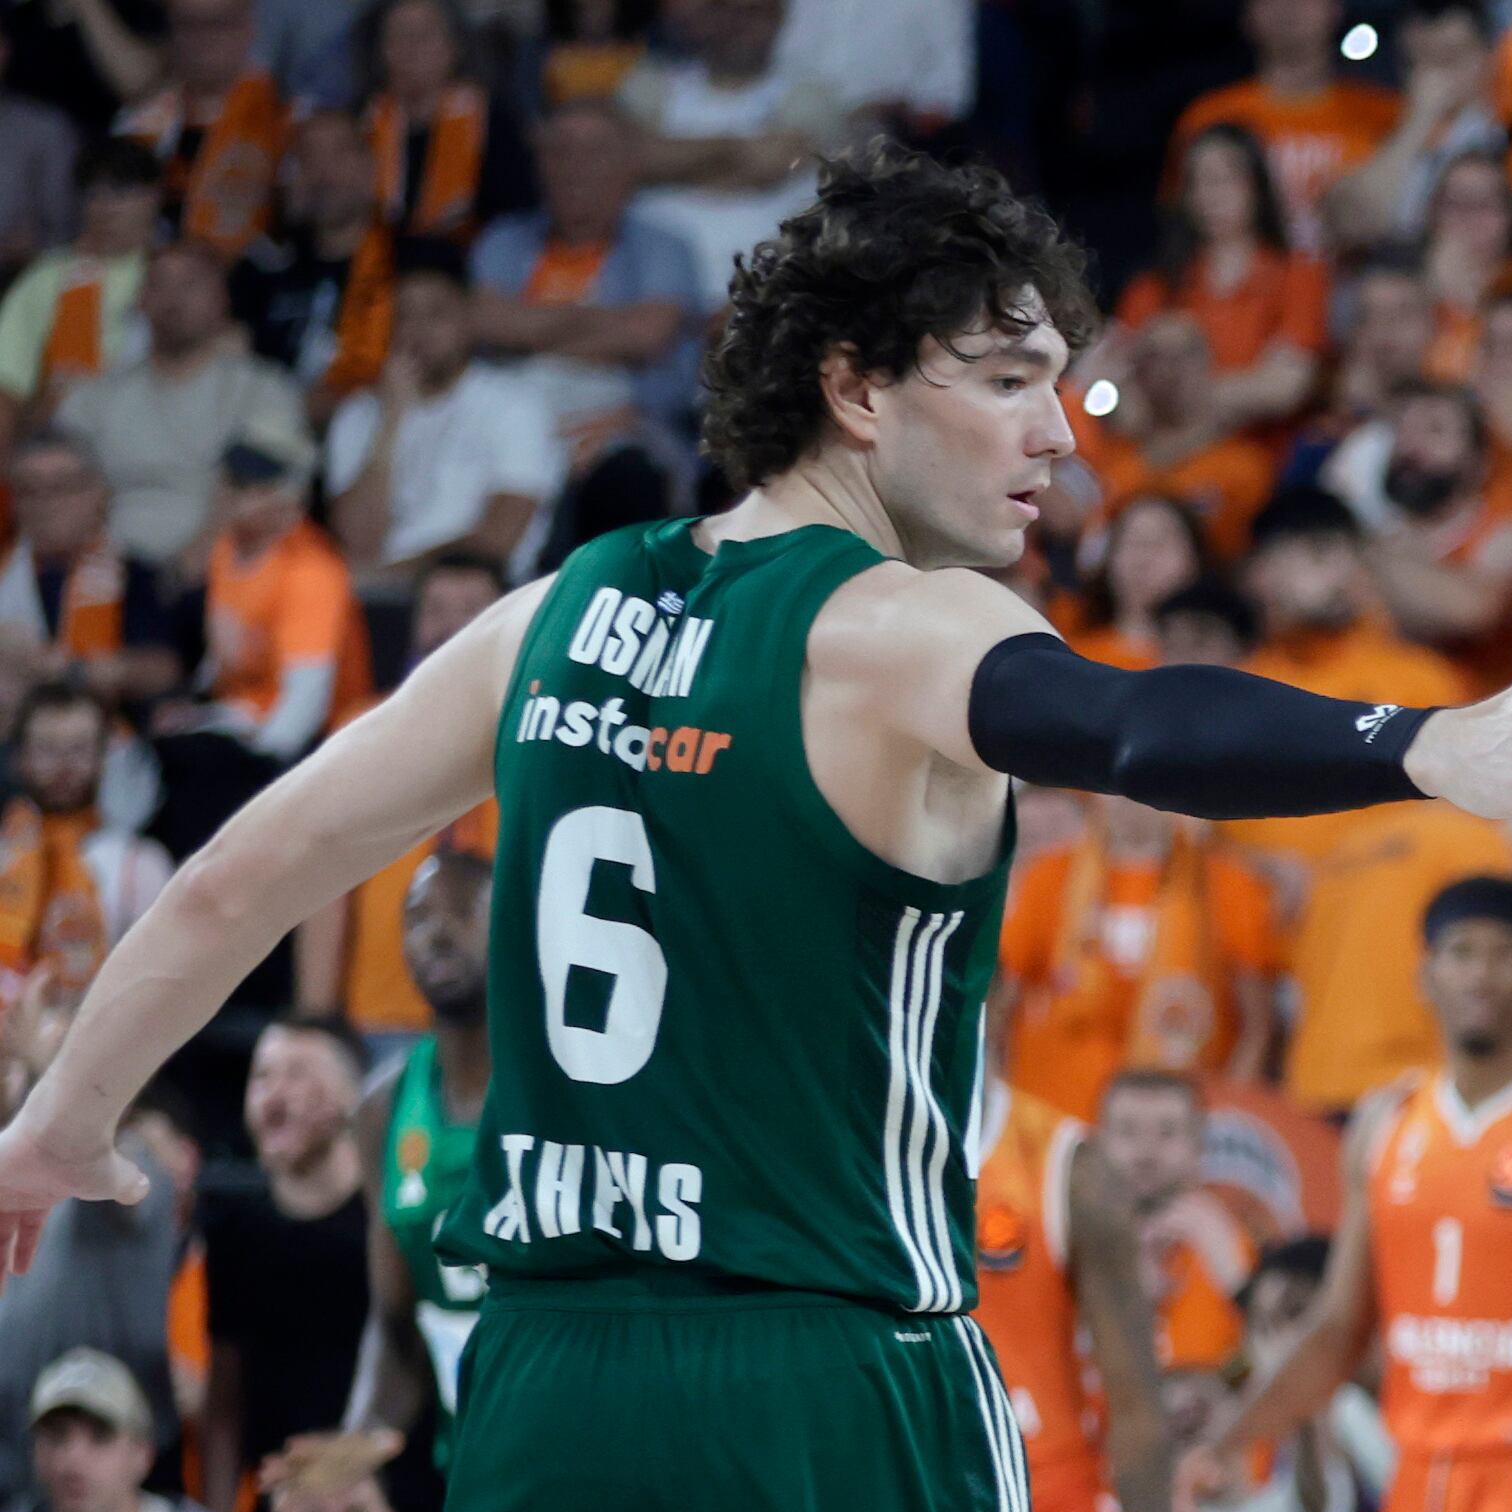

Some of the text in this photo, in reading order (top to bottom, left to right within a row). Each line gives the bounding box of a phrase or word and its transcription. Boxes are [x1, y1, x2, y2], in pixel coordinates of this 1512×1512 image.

[516, 679, 733, 775] instacar
[536, 804, 669, 1085] 6
[1432, 1216, 1464, 1307] 1
